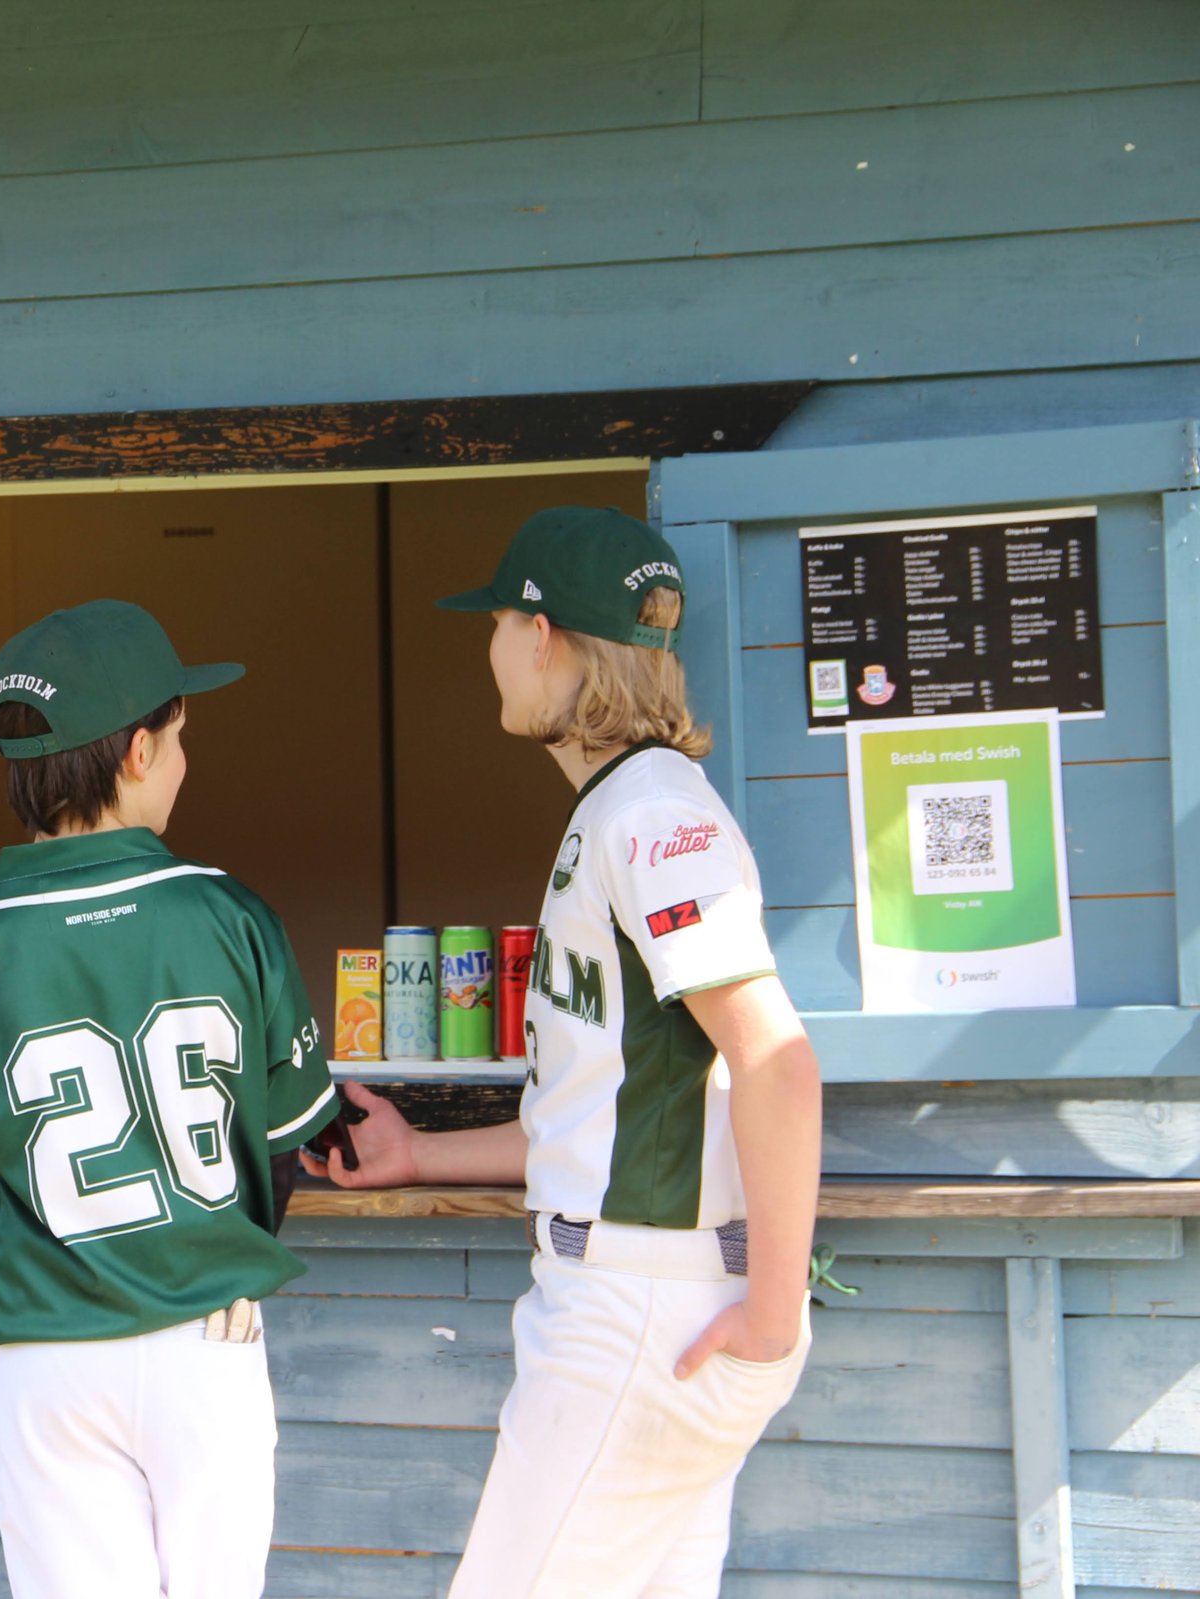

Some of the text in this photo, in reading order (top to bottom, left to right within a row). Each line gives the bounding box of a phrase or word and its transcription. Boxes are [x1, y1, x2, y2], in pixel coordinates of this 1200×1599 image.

[891, 744, 1021, 765] Betala med Swish
[65, 903, 137, 926] NORTH SIDE SPORT
[342, 955, 377, 971] MER
[3, 996, 243, 1246] 26
